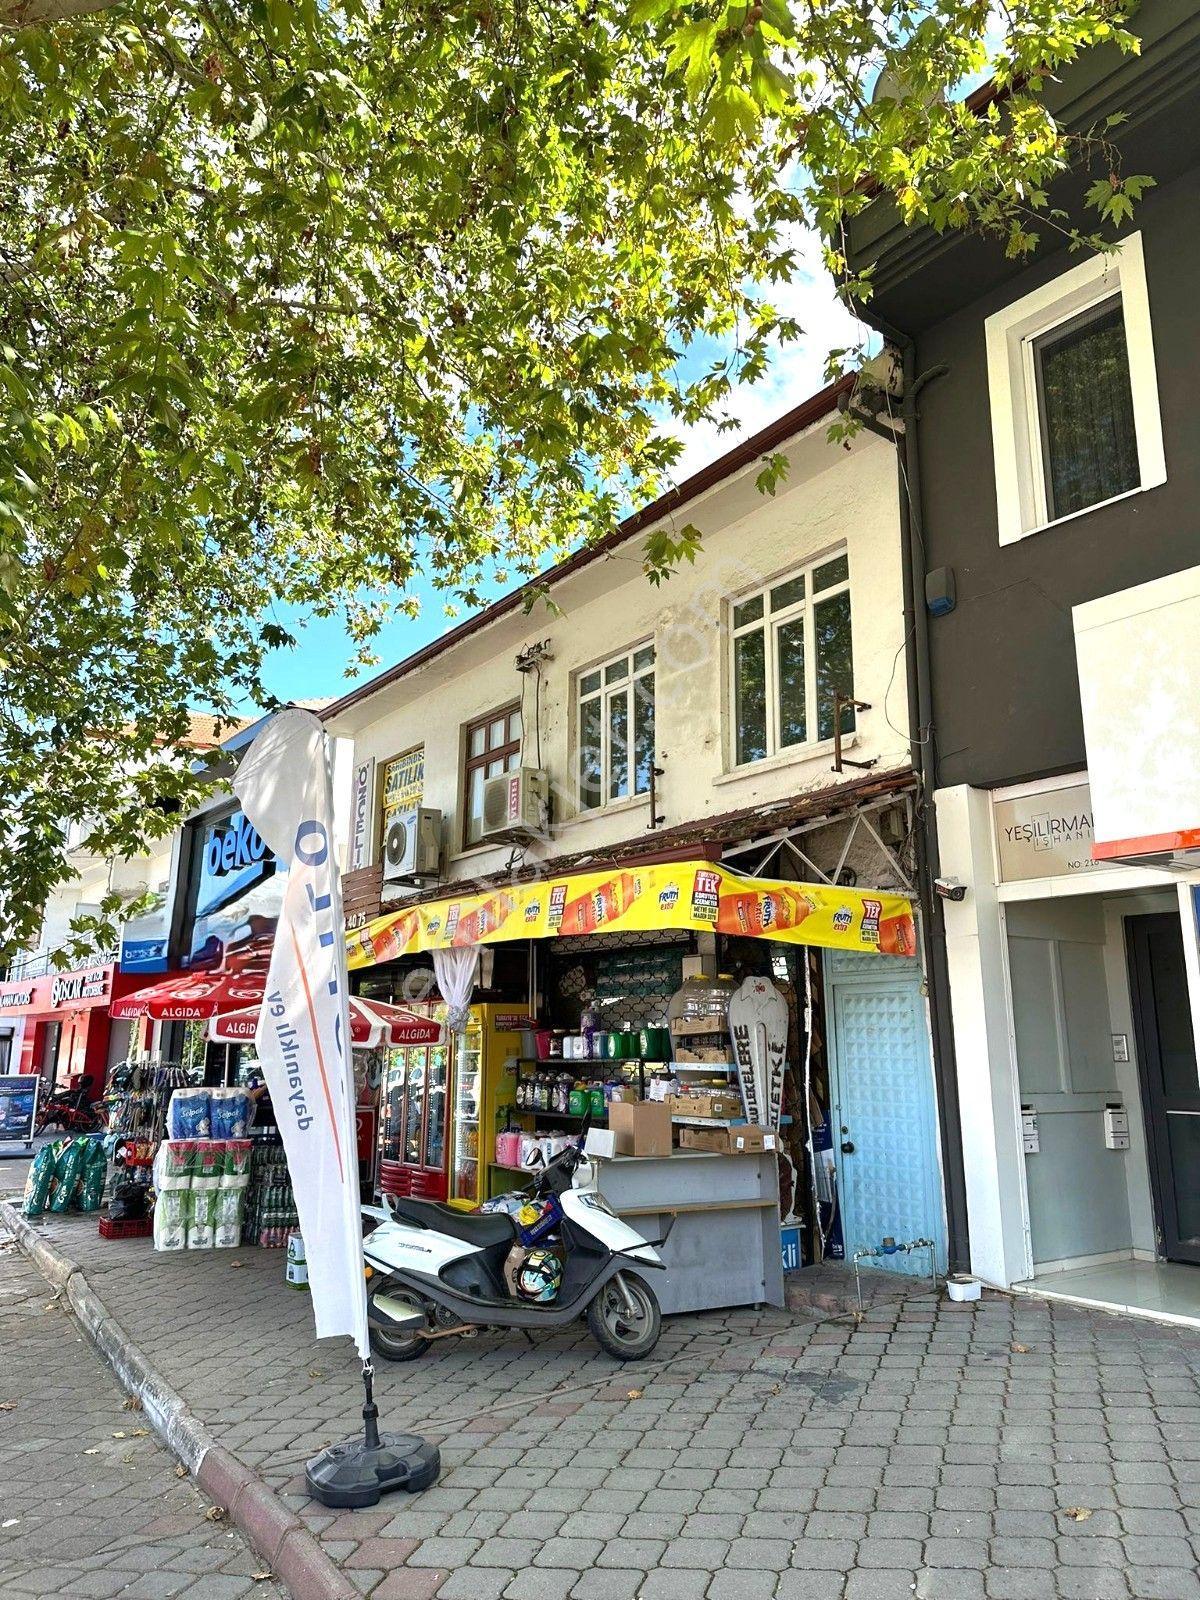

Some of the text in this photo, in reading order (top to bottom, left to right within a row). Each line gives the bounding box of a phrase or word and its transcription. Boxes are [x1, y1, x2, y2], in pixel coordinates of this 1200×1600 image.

[207, 814, 265, 876] beko
[697, 878, 718, 893] TEK
[226, 1022, 256, 1033] ALGiD
